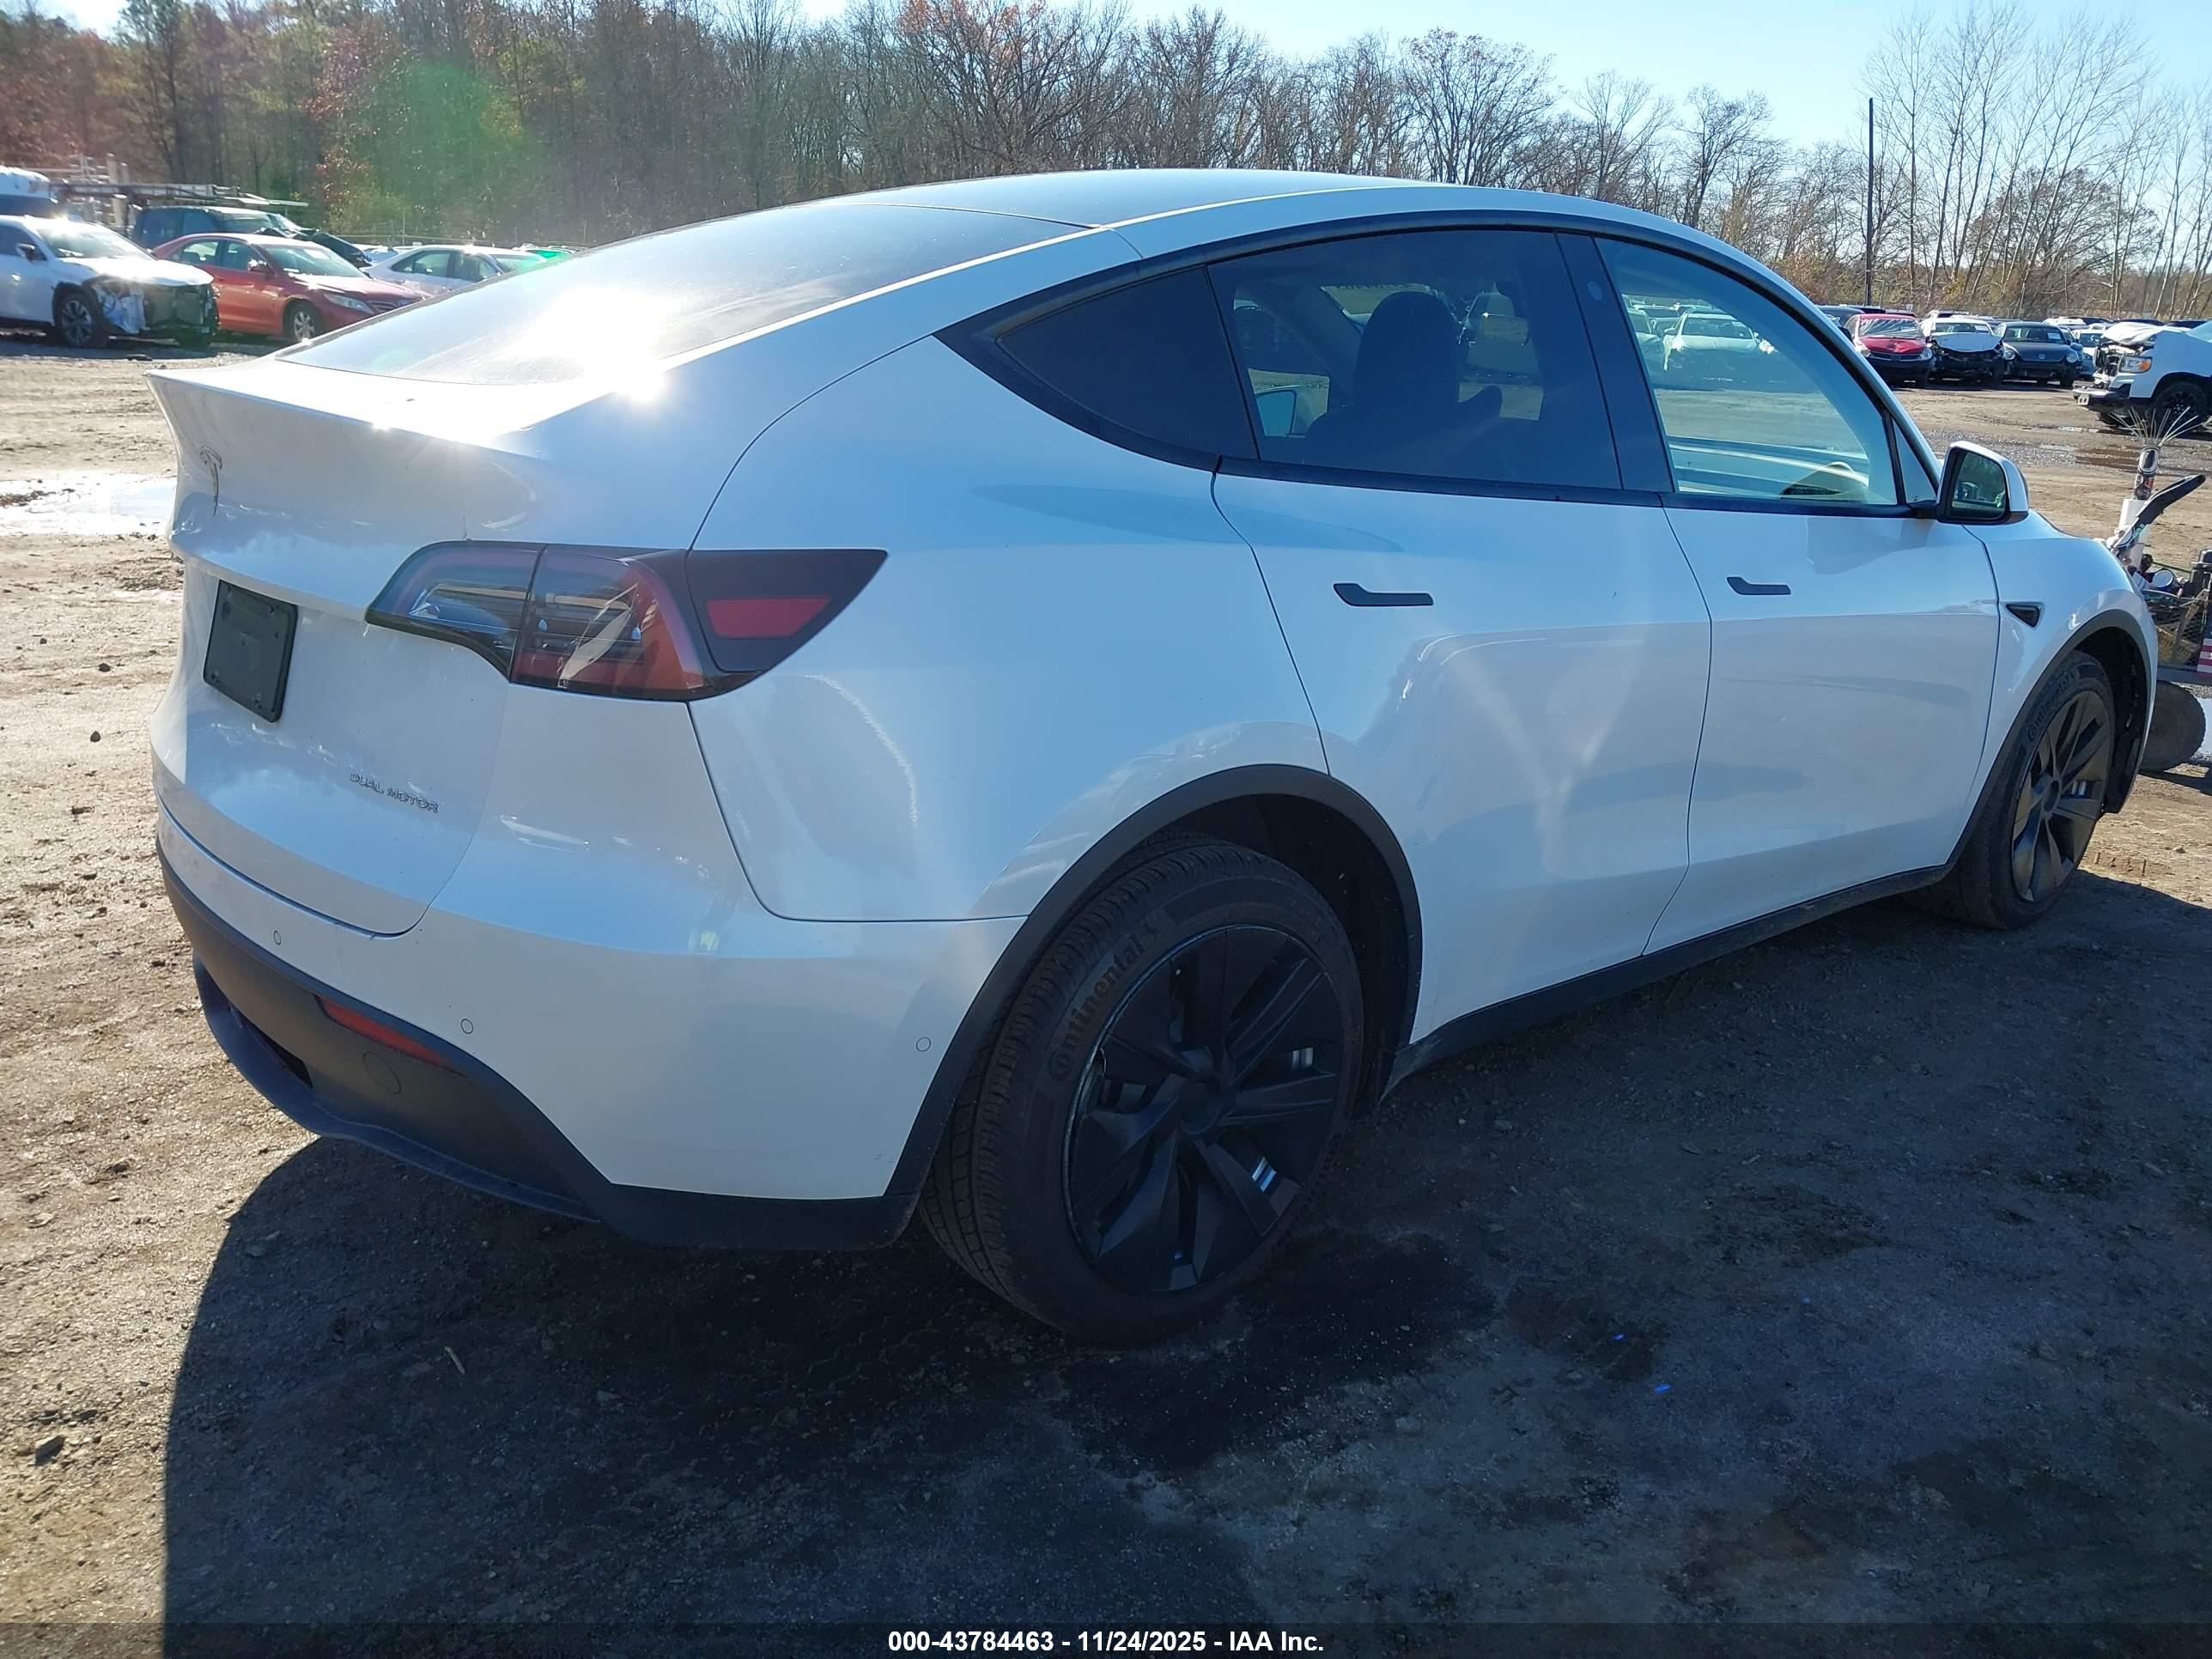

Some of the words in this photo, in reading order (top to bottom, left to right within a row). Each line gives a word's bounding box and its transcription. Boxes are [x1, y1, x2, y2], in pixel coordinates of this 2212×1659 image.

[349, 772, 384, 794] DUAL
[386, 787, 439, 813] MOTOR
[1047, 933, 1146, 1080] Continental
